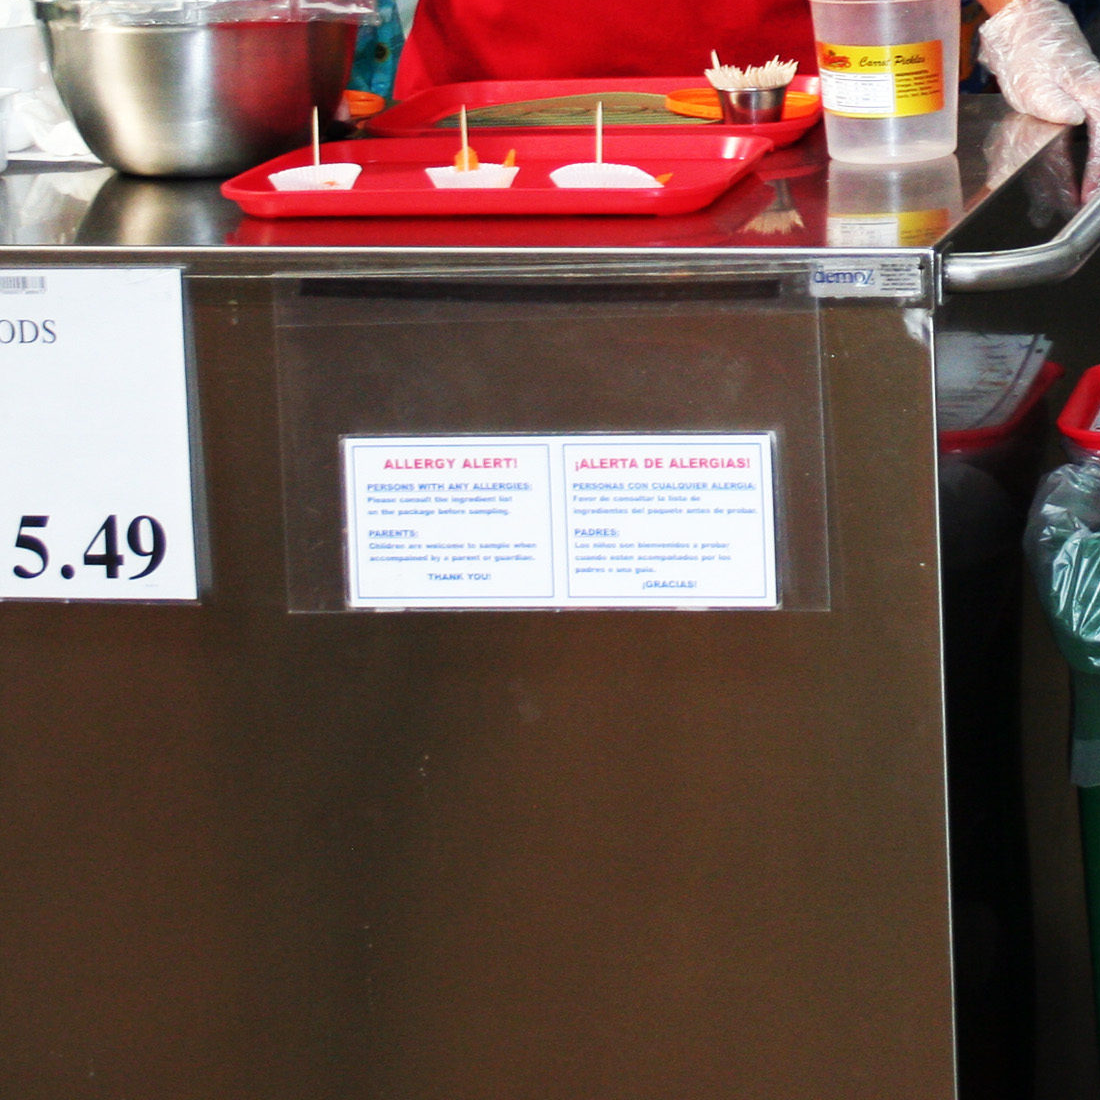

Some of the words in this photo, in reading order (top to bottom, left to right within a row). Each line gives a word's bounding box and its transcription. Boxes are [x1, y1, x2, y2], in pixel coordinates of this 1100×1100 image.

[0, 318, 57, 344] ODS
[383, 457, 457, 470] ALLERGY
[461, 457, 518, 469] ALERT!
[575, 457, 639, 472] ¡ALERTA
[644, 458, 664, 469] DE
[669, 457, 751, 469] ALERGIAS!
[367, 483, 415, 492] PERSONS
[418, 483, 445, 491] WITH
[448, 483, 469, 491] ANY
[472, 482, 532, 491] ALLERGIES:
[572, 482, 625, 491] PERSONAS
[627, 482, 649, 491] CON
[652, 482, 709, 490] CUALQUIER
[711, 482, 757, 491] ALERGIA:
[367, 496, 397, 504] Please
[399, 496, 432, 504] consult
[451, 495, 497, 505] ingredient
[600, 495, 610, 503] de
[381, 508, 396, 516] the
[398, 508, 436, 518] package
[438, 508, 466, 516] before
[573, 507, 629, 517] ingredientes
[648, 508, 683, 516] paquete
[714, 507, 724, 515] de
[368, 529, 418, 539] PARENTS:
[574, 528, 620, 538] PADRES:
[13, 514, 167, 580] 5.49
[368, 542, 406, 550] Children
[480, 542, 511, 551] sample
[638, 541, 691, 549] bienvenidos
[430, 554, 441, 563] by
[452, 555, 481, 563] parent
[427, 573, 464, 581] THANK
[467, 572, 492, 581] YOU!
[642, 579, 697, 590] ¡GRACIAS!
